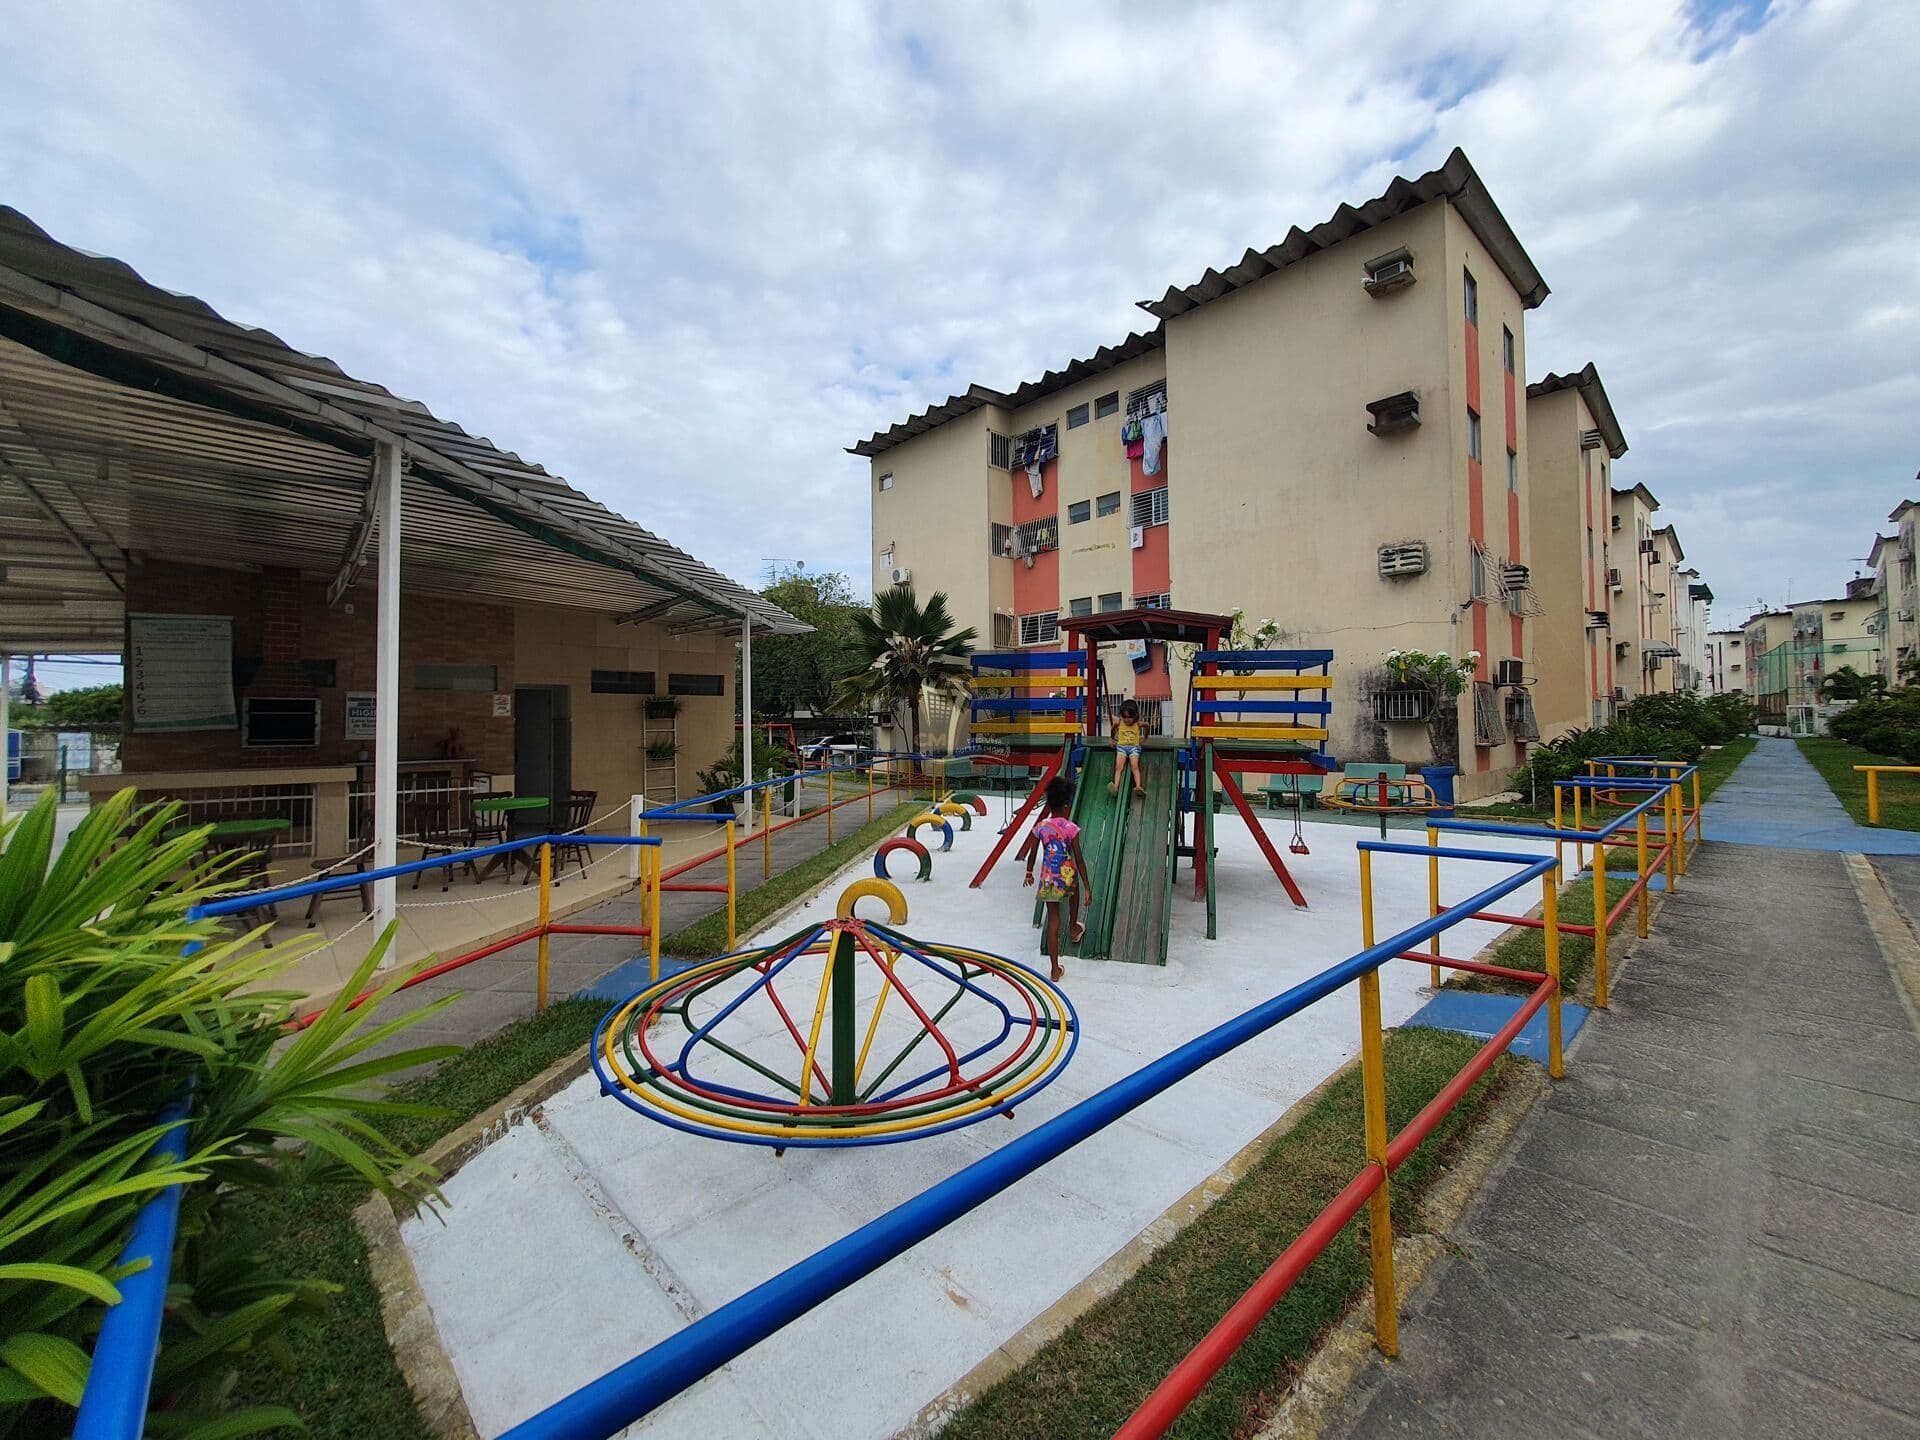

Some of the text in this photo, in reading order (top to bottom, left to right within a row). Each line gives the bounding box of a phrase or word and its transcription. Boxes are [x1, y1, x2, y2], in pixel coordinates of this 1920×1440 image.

[136, 658, 144, 668] 2
[136, 670, 144, 680] 3
[137, 693, 146, 704] 5
